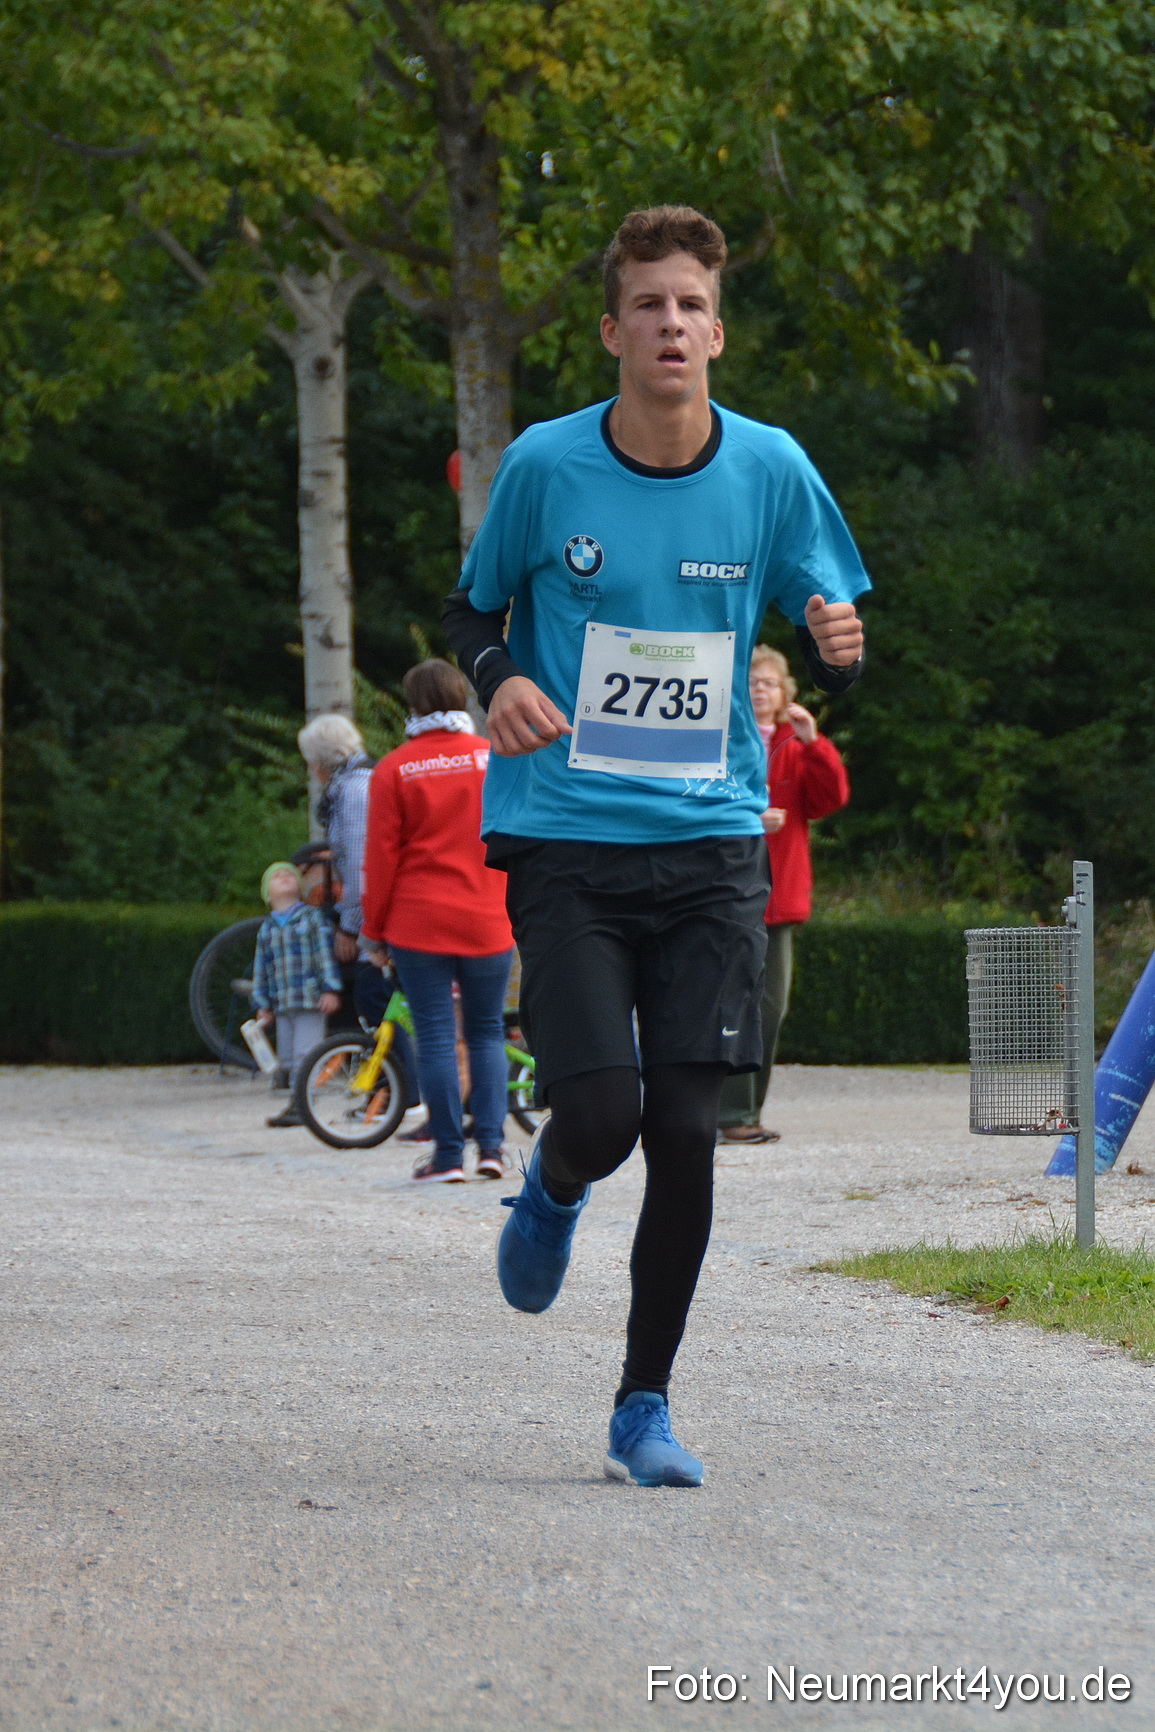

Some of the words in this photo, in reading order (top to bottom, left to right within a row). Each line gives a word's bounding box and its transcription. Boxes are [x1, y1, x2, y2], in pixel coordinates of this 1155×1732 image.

[567, 536, 600, 551] BMW
[680, 560, 749, 580] BOCK
[646, 644, 695, 658] BOCK
[600, 672, 708, 720] 2735
[584, 705, 591, 714] D
[399, 753, 474, 776] raumbox
